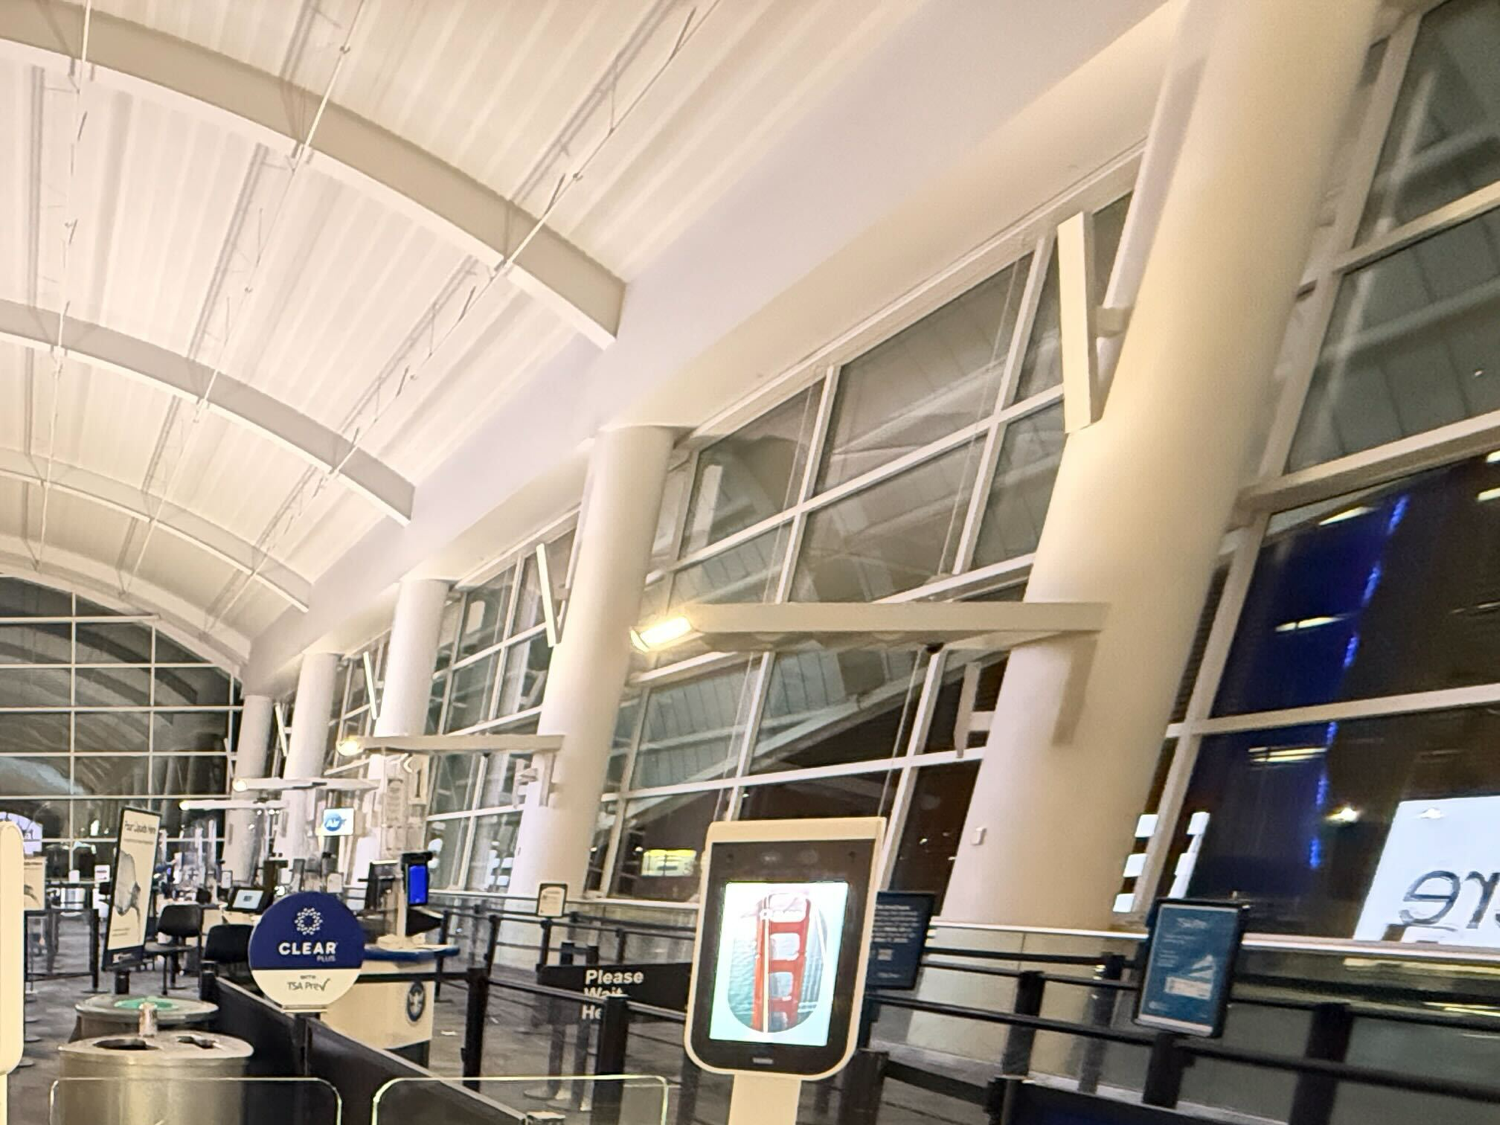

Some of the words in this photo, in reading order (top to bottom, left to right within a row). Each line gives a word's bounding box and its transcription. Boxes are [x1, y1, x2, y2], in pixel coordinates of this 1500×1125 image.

[278, 942, 337, 956] CLEAR
[585, 969, 644, 985] Please
[287, 981, 304, 991] TSA
[582, 1004, 602, 1020] He
